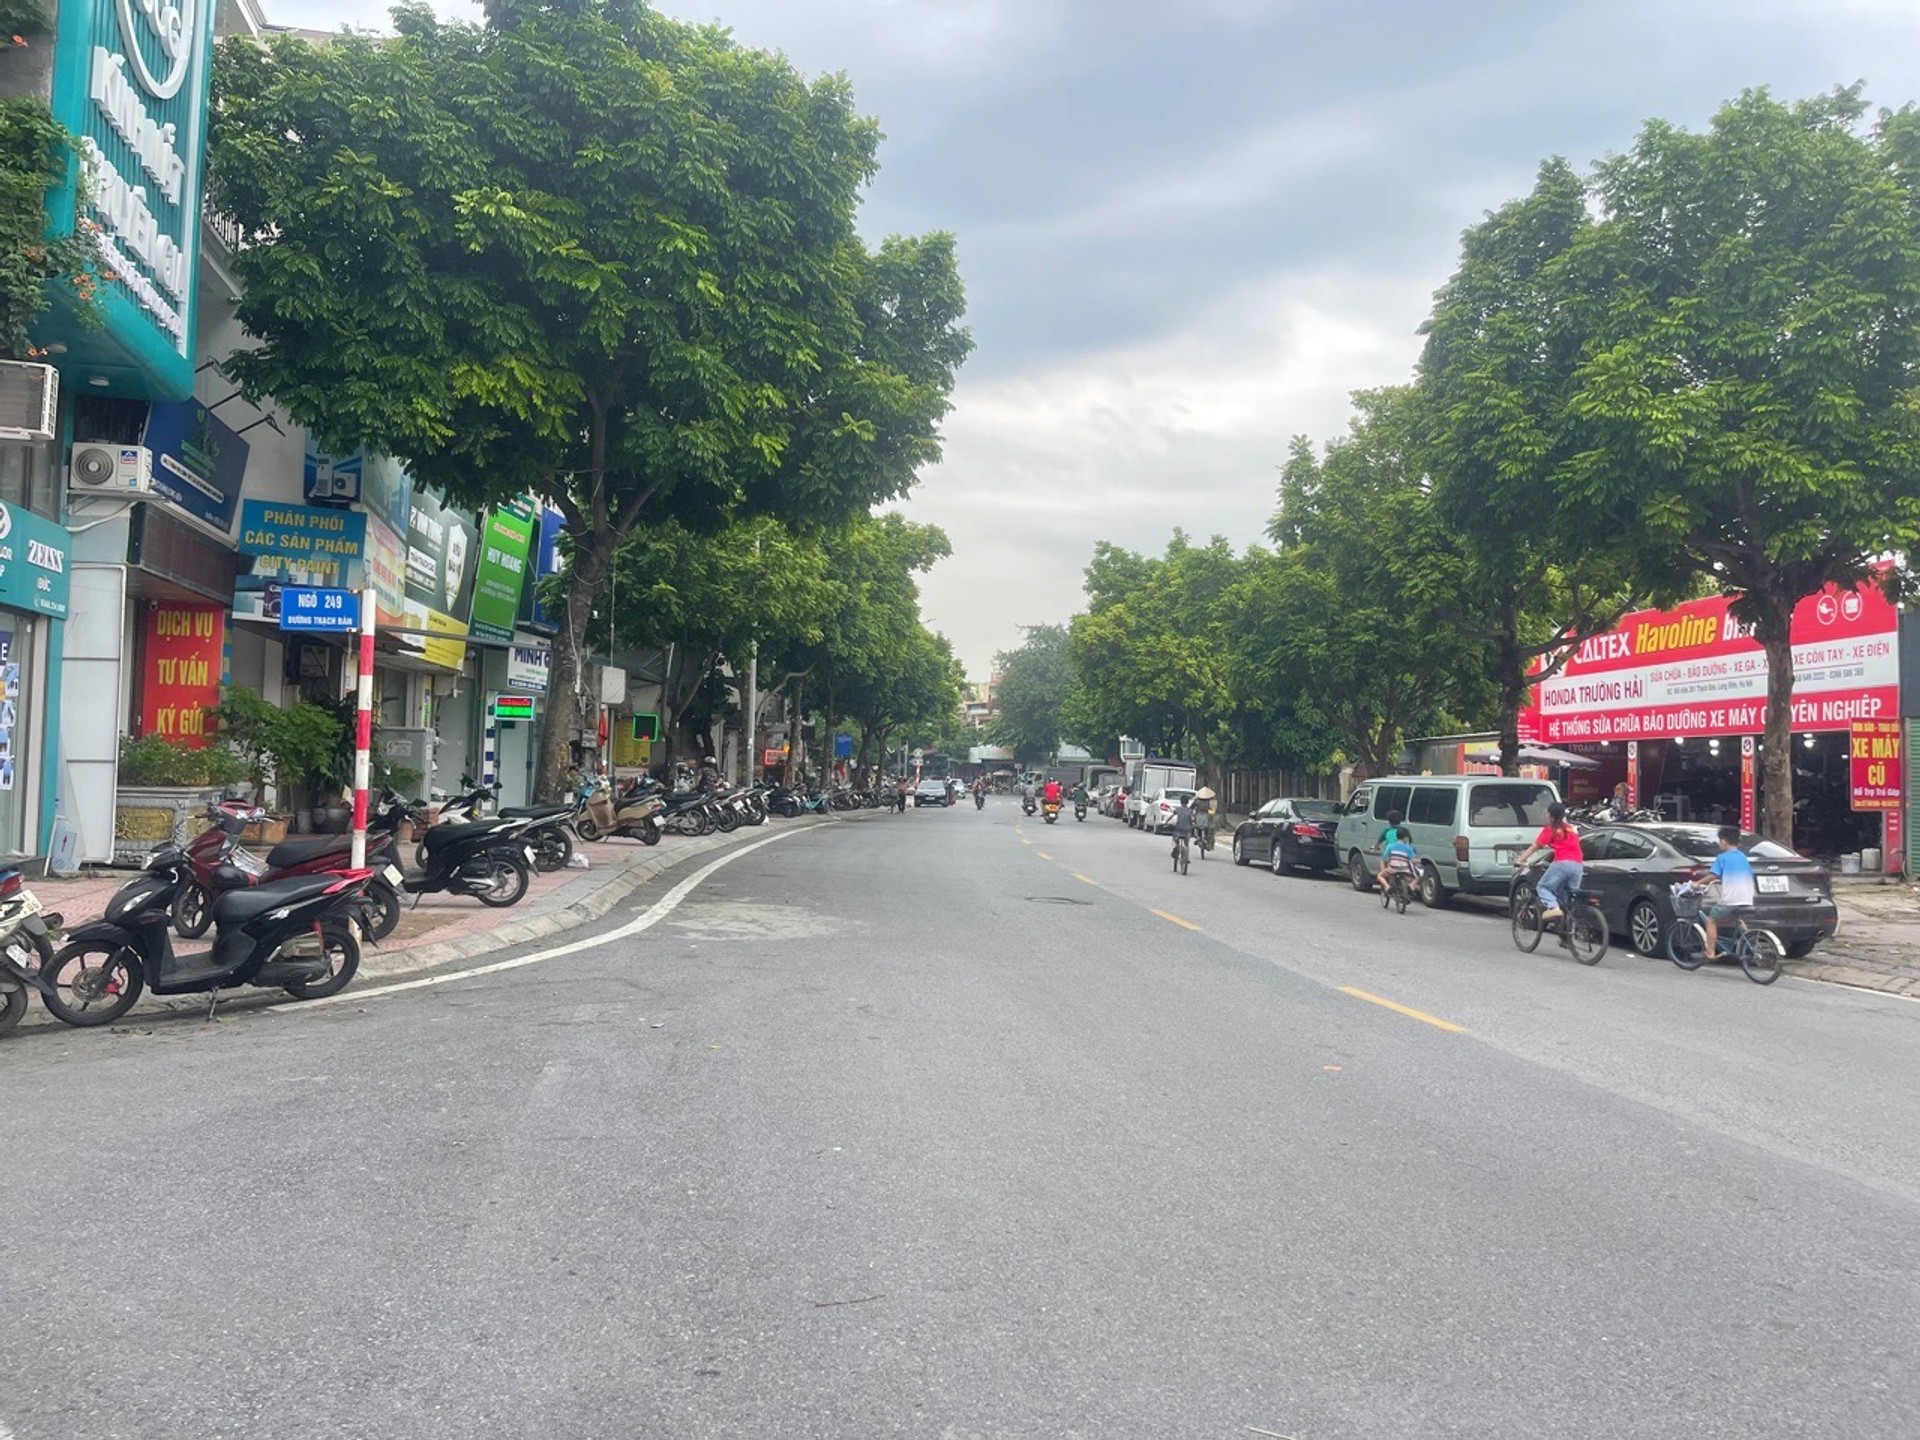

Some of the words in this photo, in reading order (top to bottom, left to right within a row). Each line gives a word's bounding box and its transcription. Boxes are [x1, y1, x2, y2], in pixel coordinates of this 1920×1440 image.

[264, 510, 305, 527] PHÂN
[310, 514, 345, 532] PHỐI
[244, 529, 275, 546] CÁC
[280, 532, 310, 550] SẢN
[315, 535, 359, 555] PHẨM
[27, 539, 64, 573] ZEISS
[259, 555, 293, 569] CITY
[295, 559, 340, 575] PAINT
[298, 592, 318, 608] NGÕ
[324, 594, 342, 609] 249
[157, 610, 191, 641] DỊCH
[195, 612, 213, 643] VỤ
[1635, 613, 1718, 656] Havoline
[514, 649, 542, 667] MINH
[1827, 649, 1844, 662] TAY
[1852, 646, 1864, 658] XE
[158, 658, 177, 685] TƯ
[179, 651, 208, 686] VẤN
[1545, 688, 1576, 706] HONDA
[1579, 681, 1620, 704] TRƯỜNG
[1624, 675, 1642, 699] HẢI
[157, 703, 176, 734] KÝ
[1549, 718, 1560, 740] HỆ
[1562, 715, 1591, 736] THỐNG
[1592, 714, 1612, 734] SỬA
[1614, 712, 1641, 733] CHỮA
[1643, 710, 1664, 731] BẢO
[1667, 708, 1706, 730] DƯỠNG
[1710, 709, 1726, 727] XE
[1728, 703, 1757, 726] MÁY
[1852, 737, 1869, 758] XE
[1872, 734, 1900, 758] MÁY
[1868, 761, 1885, 786] CŨ
